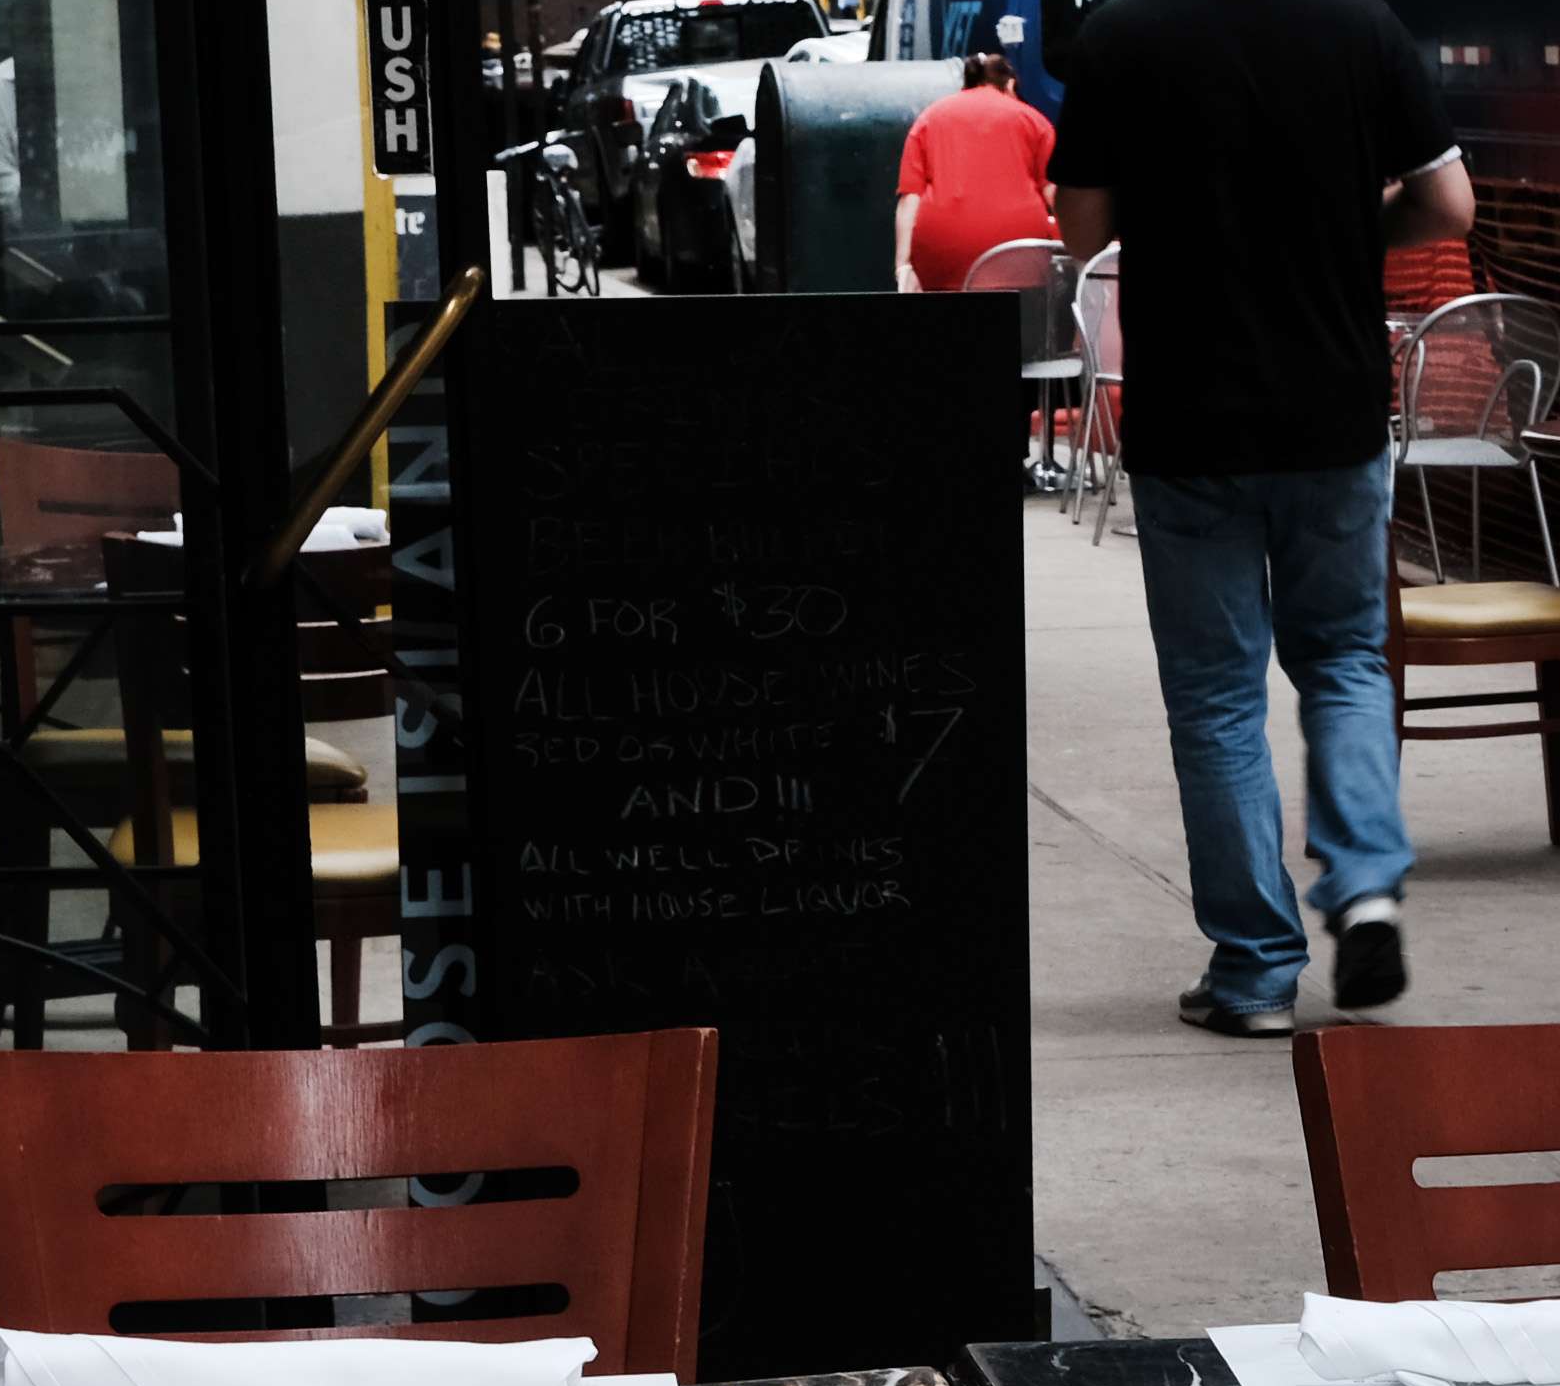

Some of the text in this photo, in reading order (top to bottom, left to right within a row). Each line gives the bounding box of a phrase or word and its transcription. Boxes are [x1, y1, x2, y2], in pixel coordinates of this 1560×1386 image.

[523, 581, 849, 648] 6 FOR $30
[513, 651, 978, 722] ALL HOUSE WINES
[689, 720, 836, 761] WHITE
[877, 703, 965, 805] $7
[520, 840, 590, 874] ALL
[605, 844, 731, 872] WELL
[523, 880, 912, 922] WITH HOUSE LIQUOR
